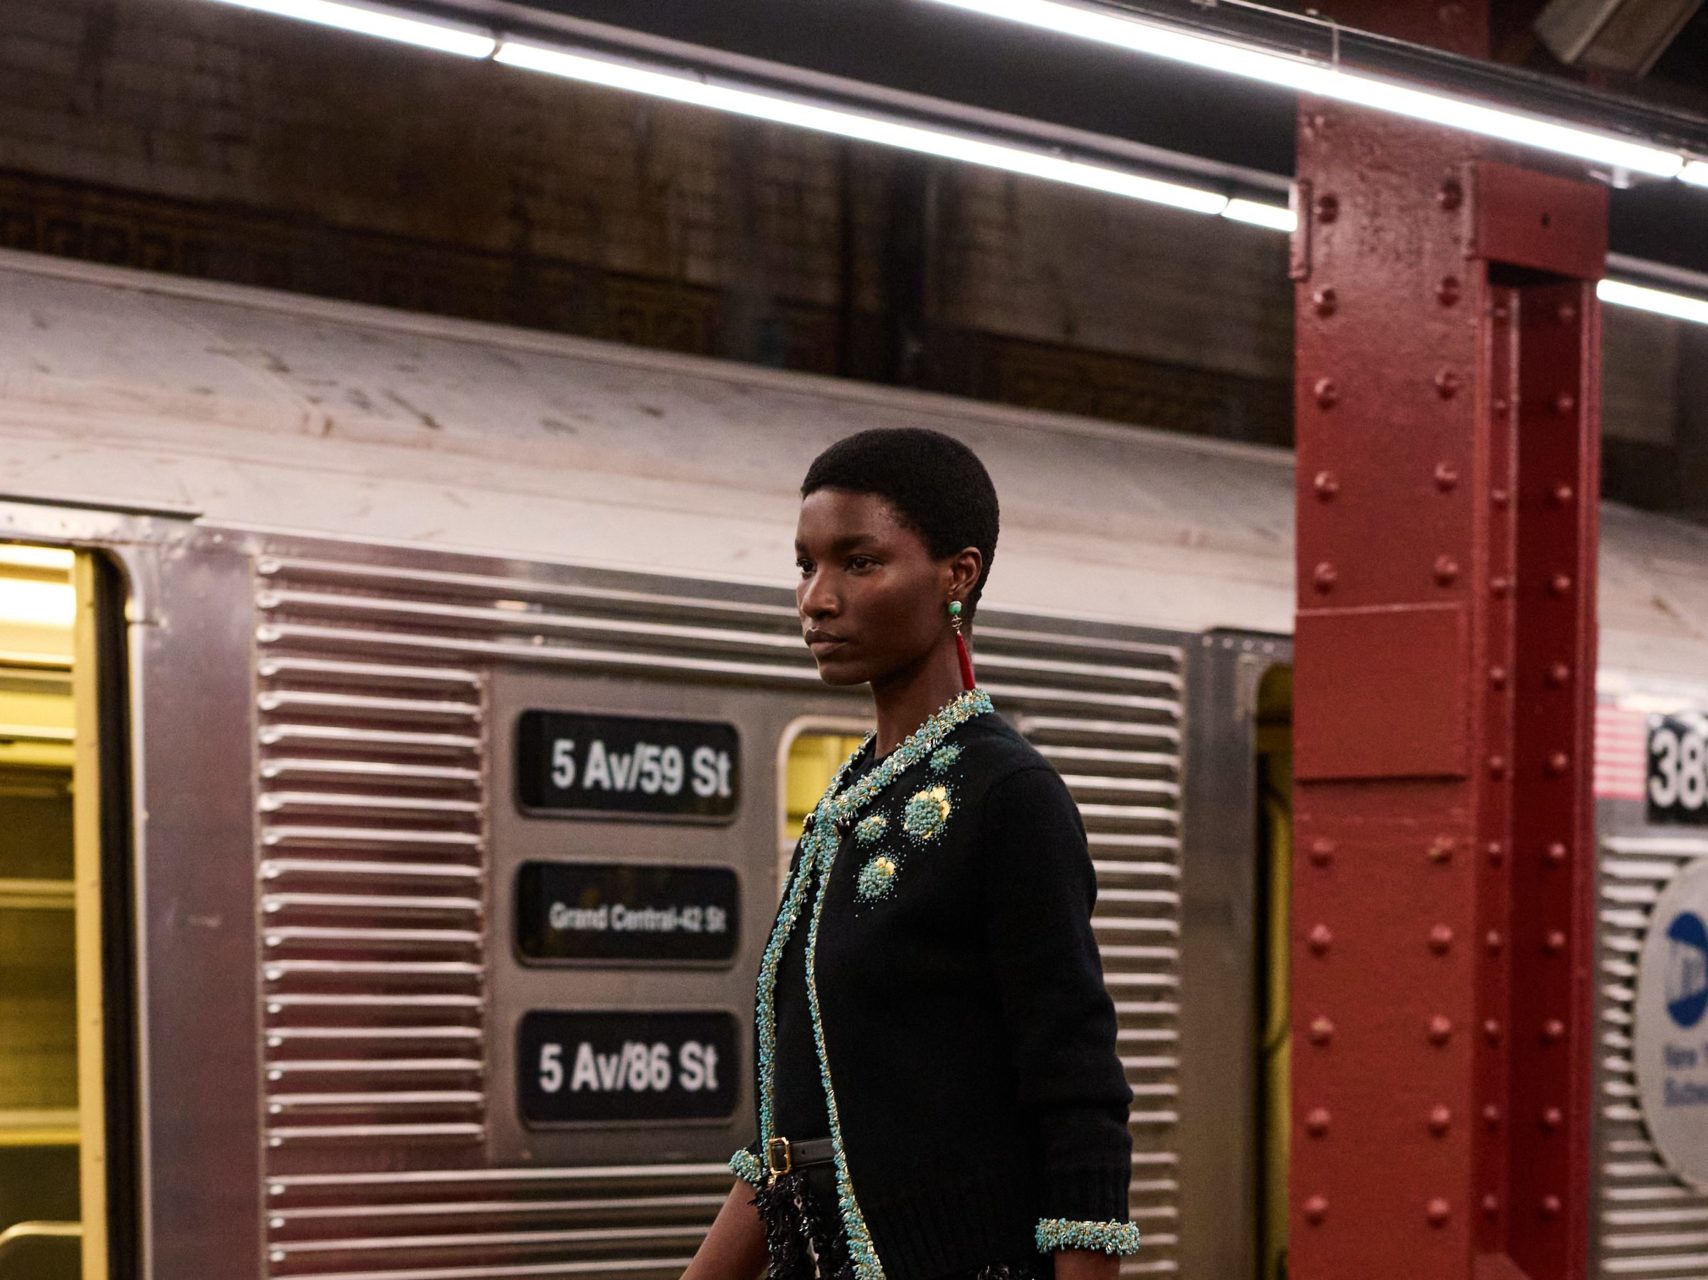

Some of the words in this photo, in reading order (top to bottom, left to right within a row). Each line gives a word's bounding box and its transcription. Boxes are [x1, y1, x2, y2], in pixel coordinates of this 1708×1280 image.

[552, 740, 576, 788] 5
[583, 741, 684, 795] Av/59
[691, 746, 732, 798] St
[1650, 729, 1708, 810] 38
[549, 902, 609, 931] Grand
[705, 907, 727, 932] St
[539, 1044, 563, 1092] 5
[571, 1042, 671, 1091] Av/86
[679, 1041, 718, 1090] St
